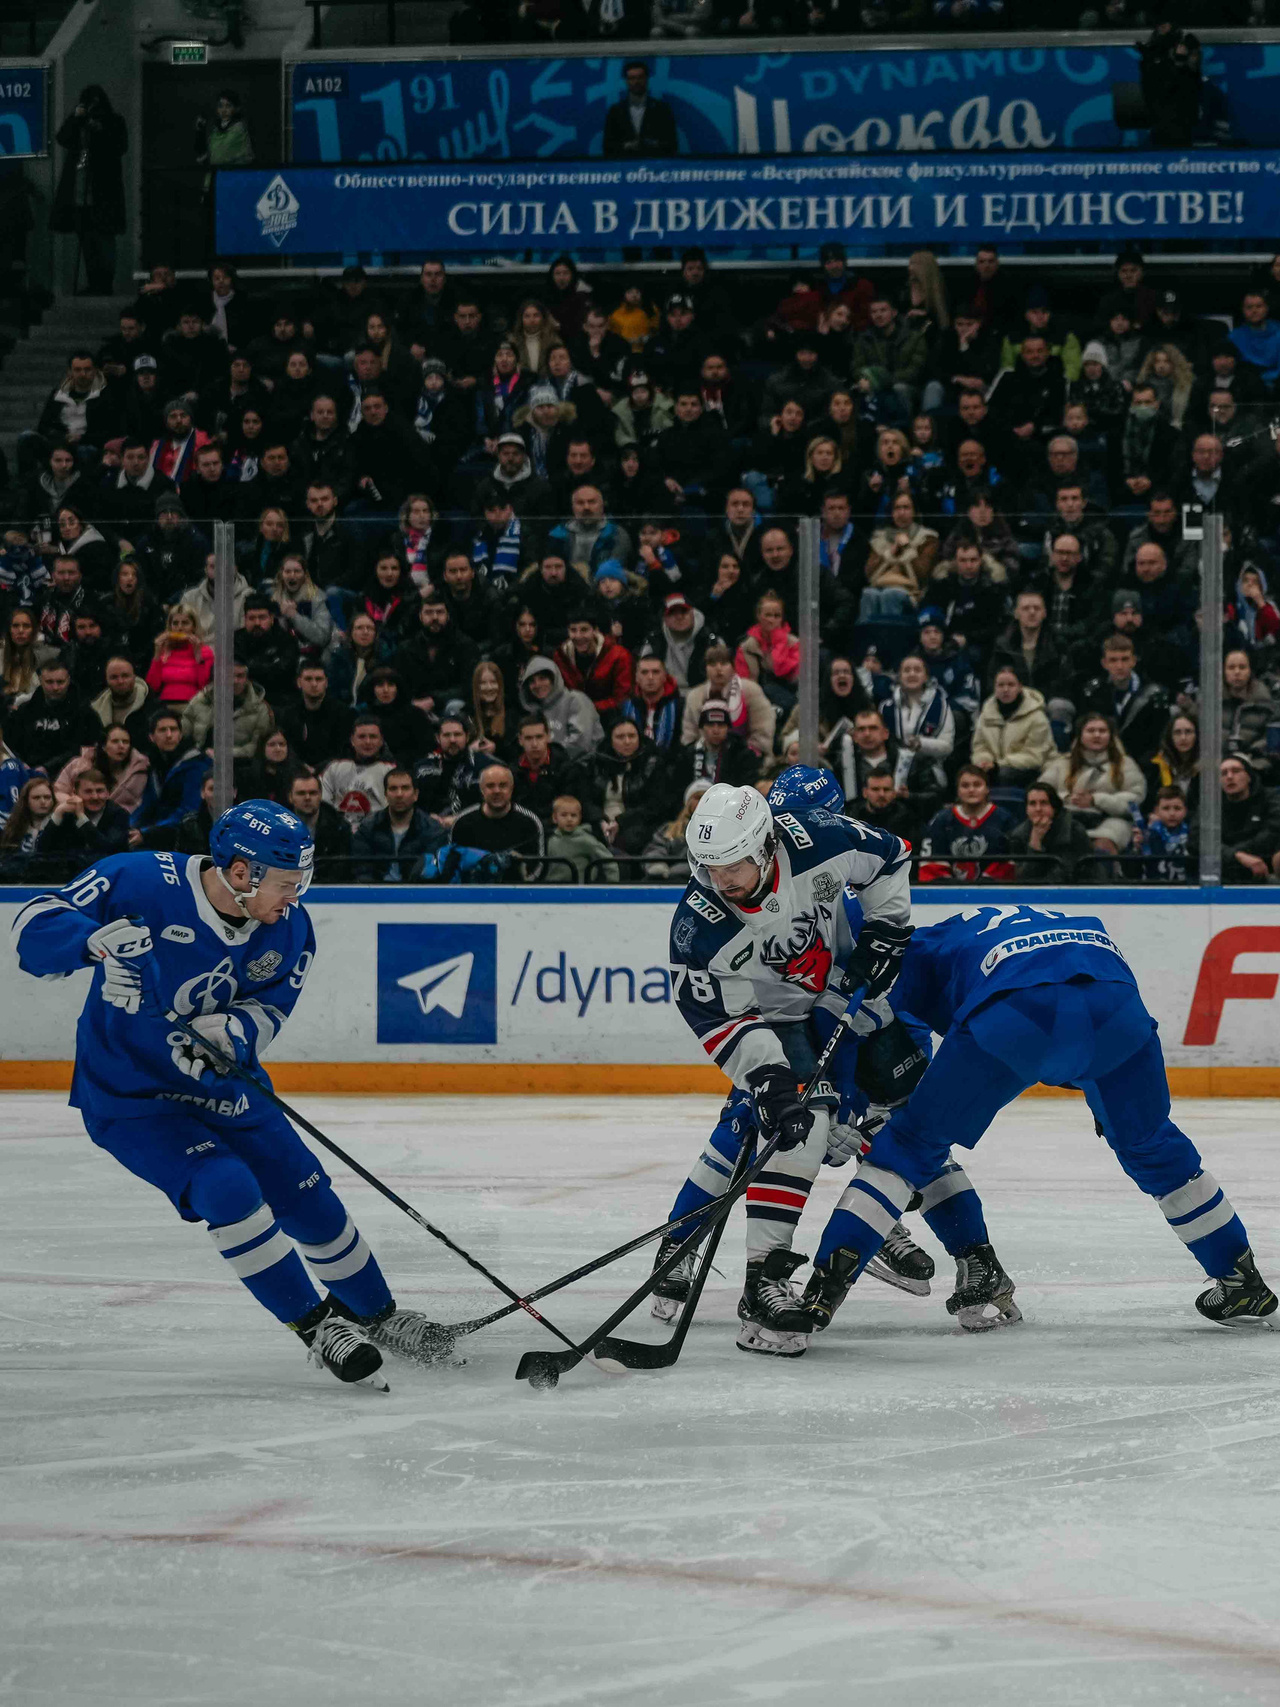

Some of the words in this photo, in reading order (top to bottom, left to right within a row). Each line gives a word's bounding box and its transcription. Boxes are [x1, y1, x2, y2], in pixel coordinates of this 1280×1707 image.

[305, 76, 342, 94] A102
[334, 169, 621, 190] Общественно-государственное
[626, 165, 746, 186] объединение
[906, 159, 1163, 183] физкультурно-спортивное
[1167, 157, 1260, 176] общество
[448, 201, 580, 237] СИЛА
[593, 199, 618, 234] В
[629, 194, 913, 240] ДВИЖЕНИИ
[933, 193, 968, 228] И
[981, 190, 1245, 234] ЕДИНСТВЕ!
[813, 776, 829, 791] ВТБ
[248, 817, 273, 836] ВТБ
[698, 824, 713, 840] 78
[233, 842, 257, 857] CCM
[154, 851, 181, 887] ВТБ
[689, 892, 723, 921] PARI
[1001, 930, 1124, 958] ТРАНСНЕФТ
[669, 963, 716, 1004] 78
[817, 1023, 843, 1067] CCM
[194, 1140, 216, 1153] ВТБ
[305, 1170, 321, 1189] ВТБ
[518, 1300, 540, 1318] CCM
